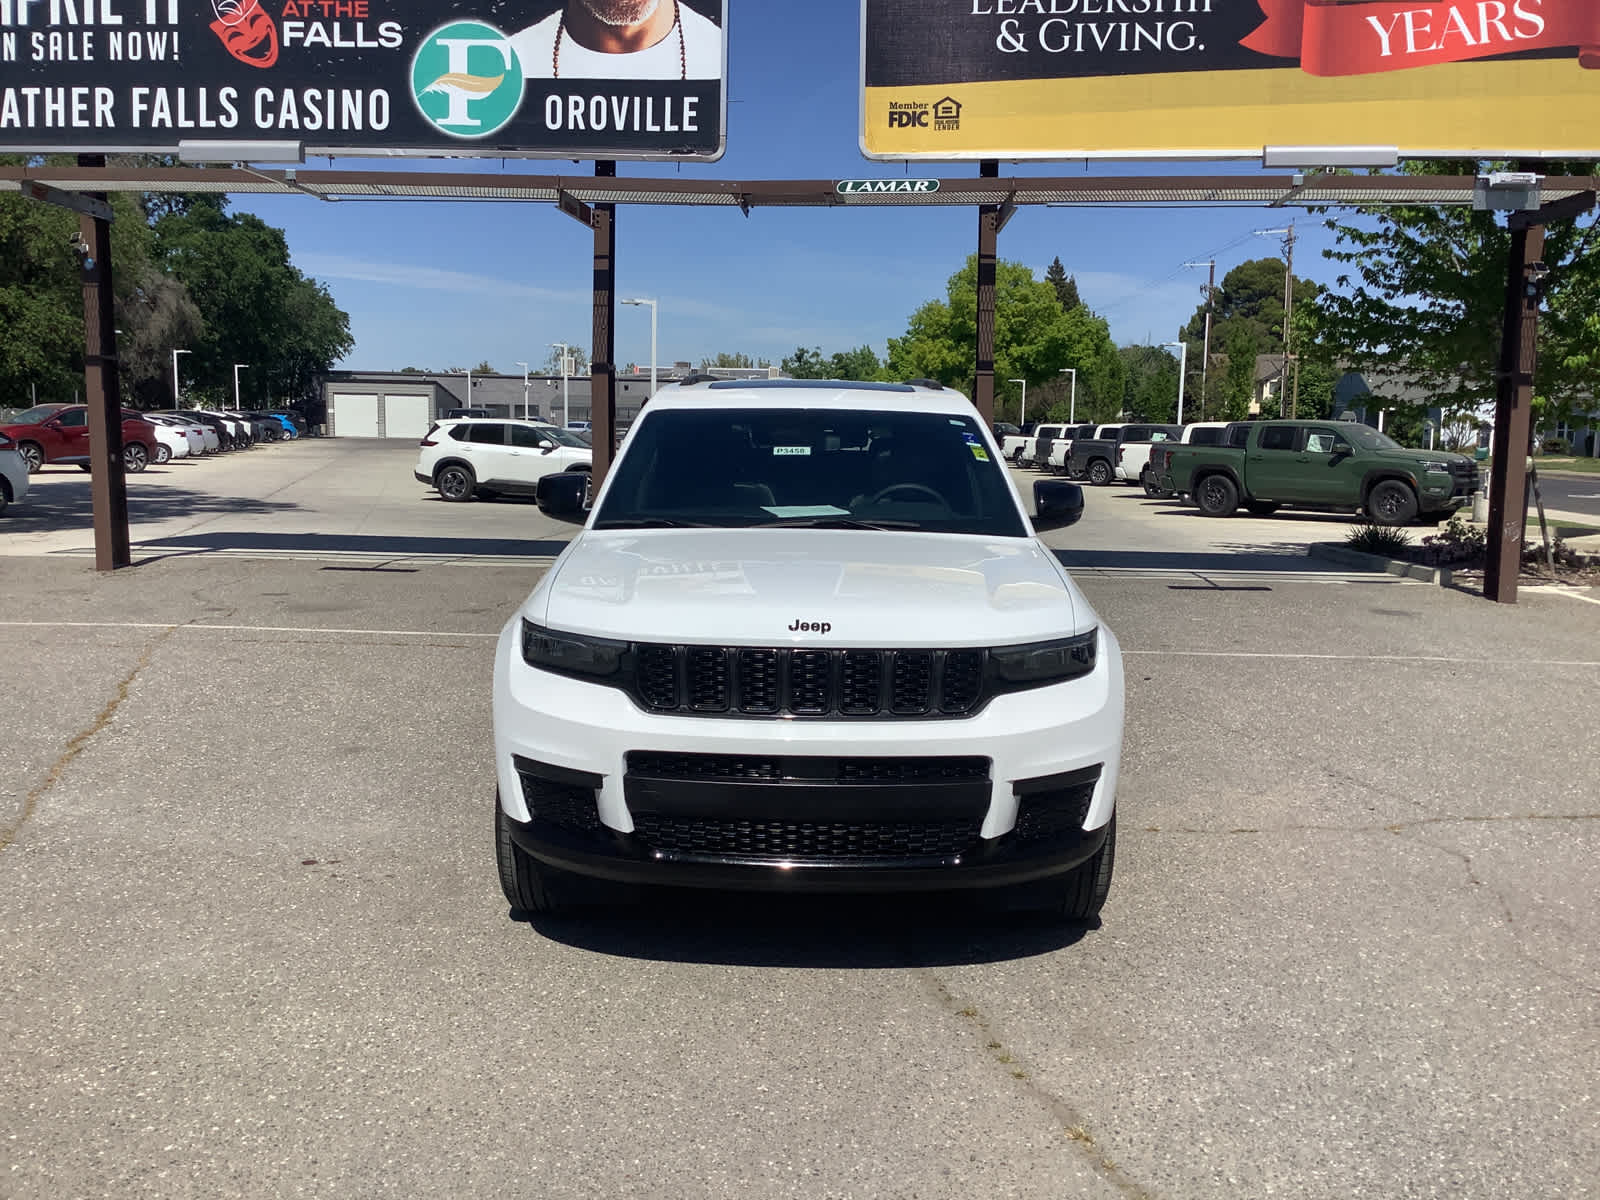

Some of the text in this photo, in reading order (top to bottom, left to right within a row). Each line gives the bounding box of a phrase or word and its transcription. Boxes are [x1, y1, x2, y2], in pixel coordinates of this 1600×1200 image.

[281, 0, 369, 18] AT THE
[283, 21, 404, 48] FALLS
[996, 18, 1205, 53] & GIVING.
[1366, 0, 1545, 57] YEARS
[31, 31, 95, 61] SALE
[109, 31, 180, 61] NOW!
[0, 86, 391, 131] ATHER FALLS CASINO
[545, 94, 699, 132] OROVILLE
[889, 101, 929, 110] Member
[888, 110, 929, 129] FDIC
[845, 181, 929, 193] LAMAR
[788, 619, 832, 635] Jeep
